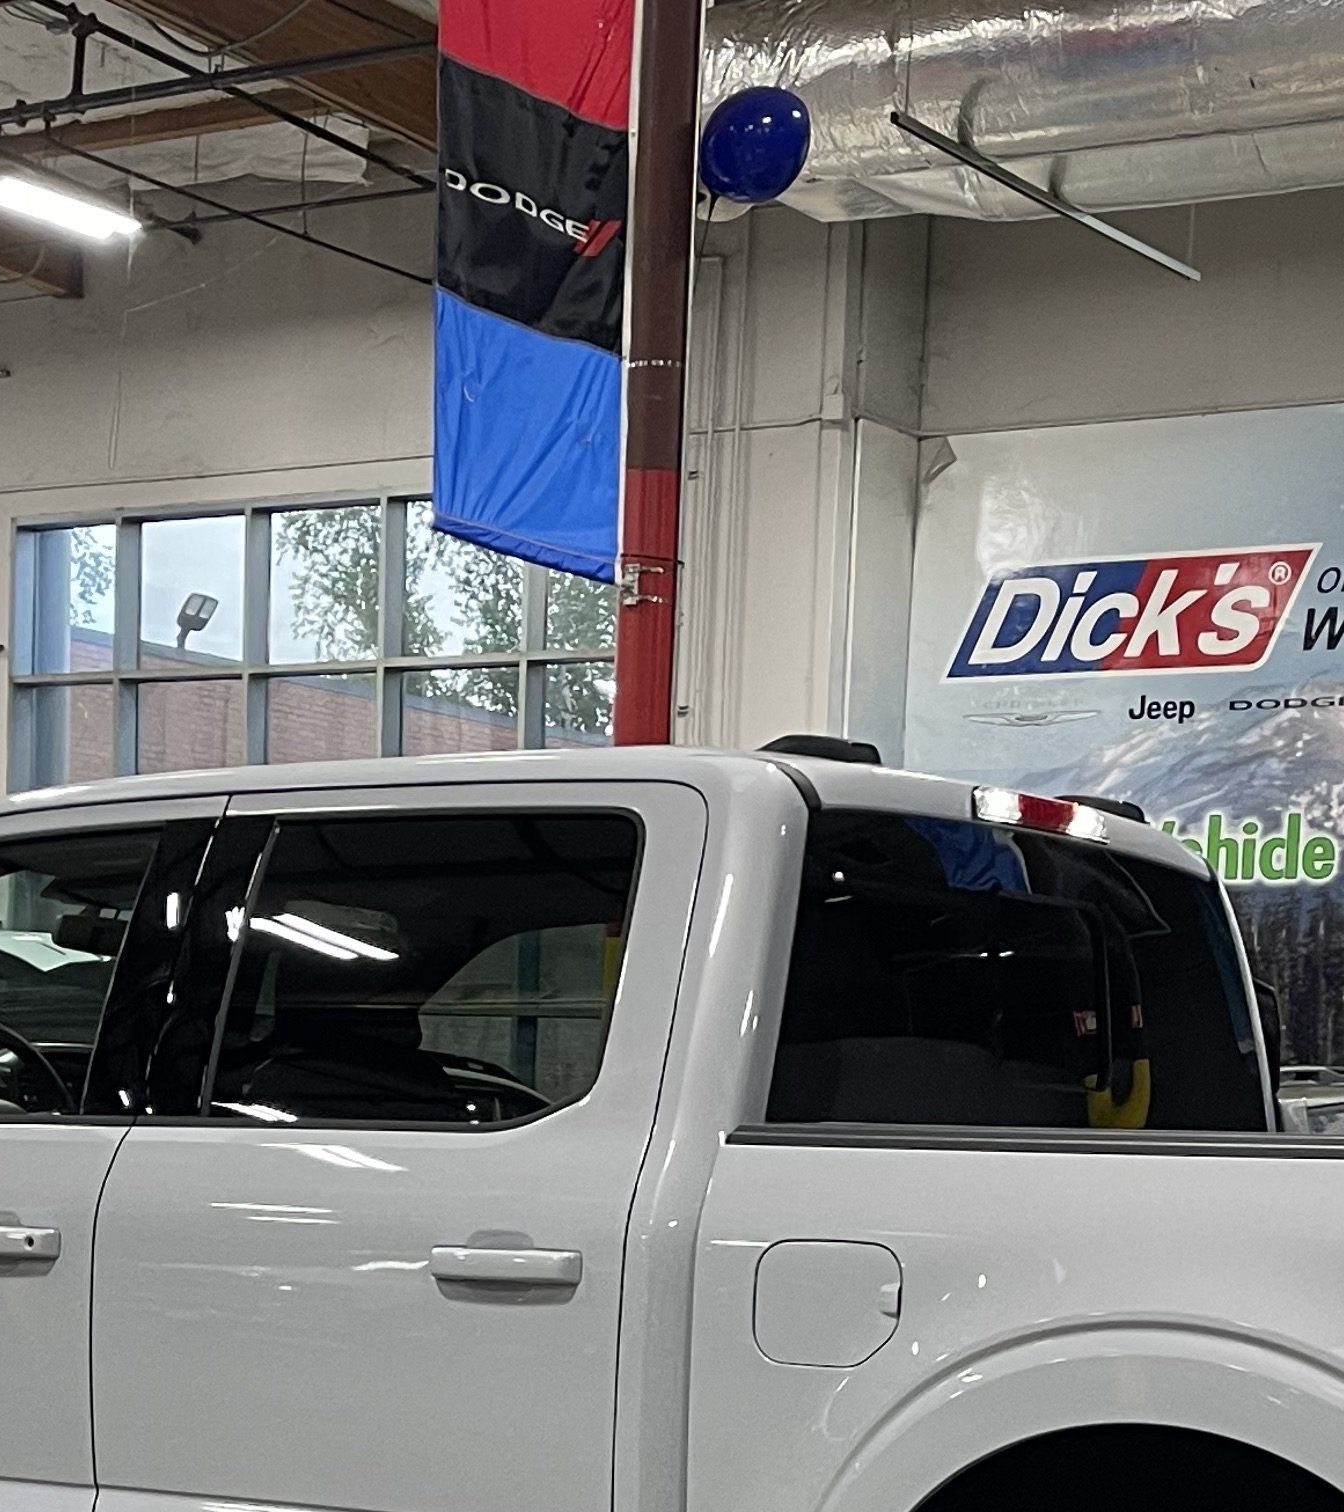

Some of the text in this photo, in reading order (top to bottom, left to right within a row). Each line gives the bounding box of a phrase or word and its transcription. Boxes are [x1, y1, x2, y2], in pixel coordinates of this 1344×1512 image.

[445, 168, 590, 243] DODGE
[1128, 694, 1195, 724] Jeep
[1162, 813, 1336, 880] hicle
